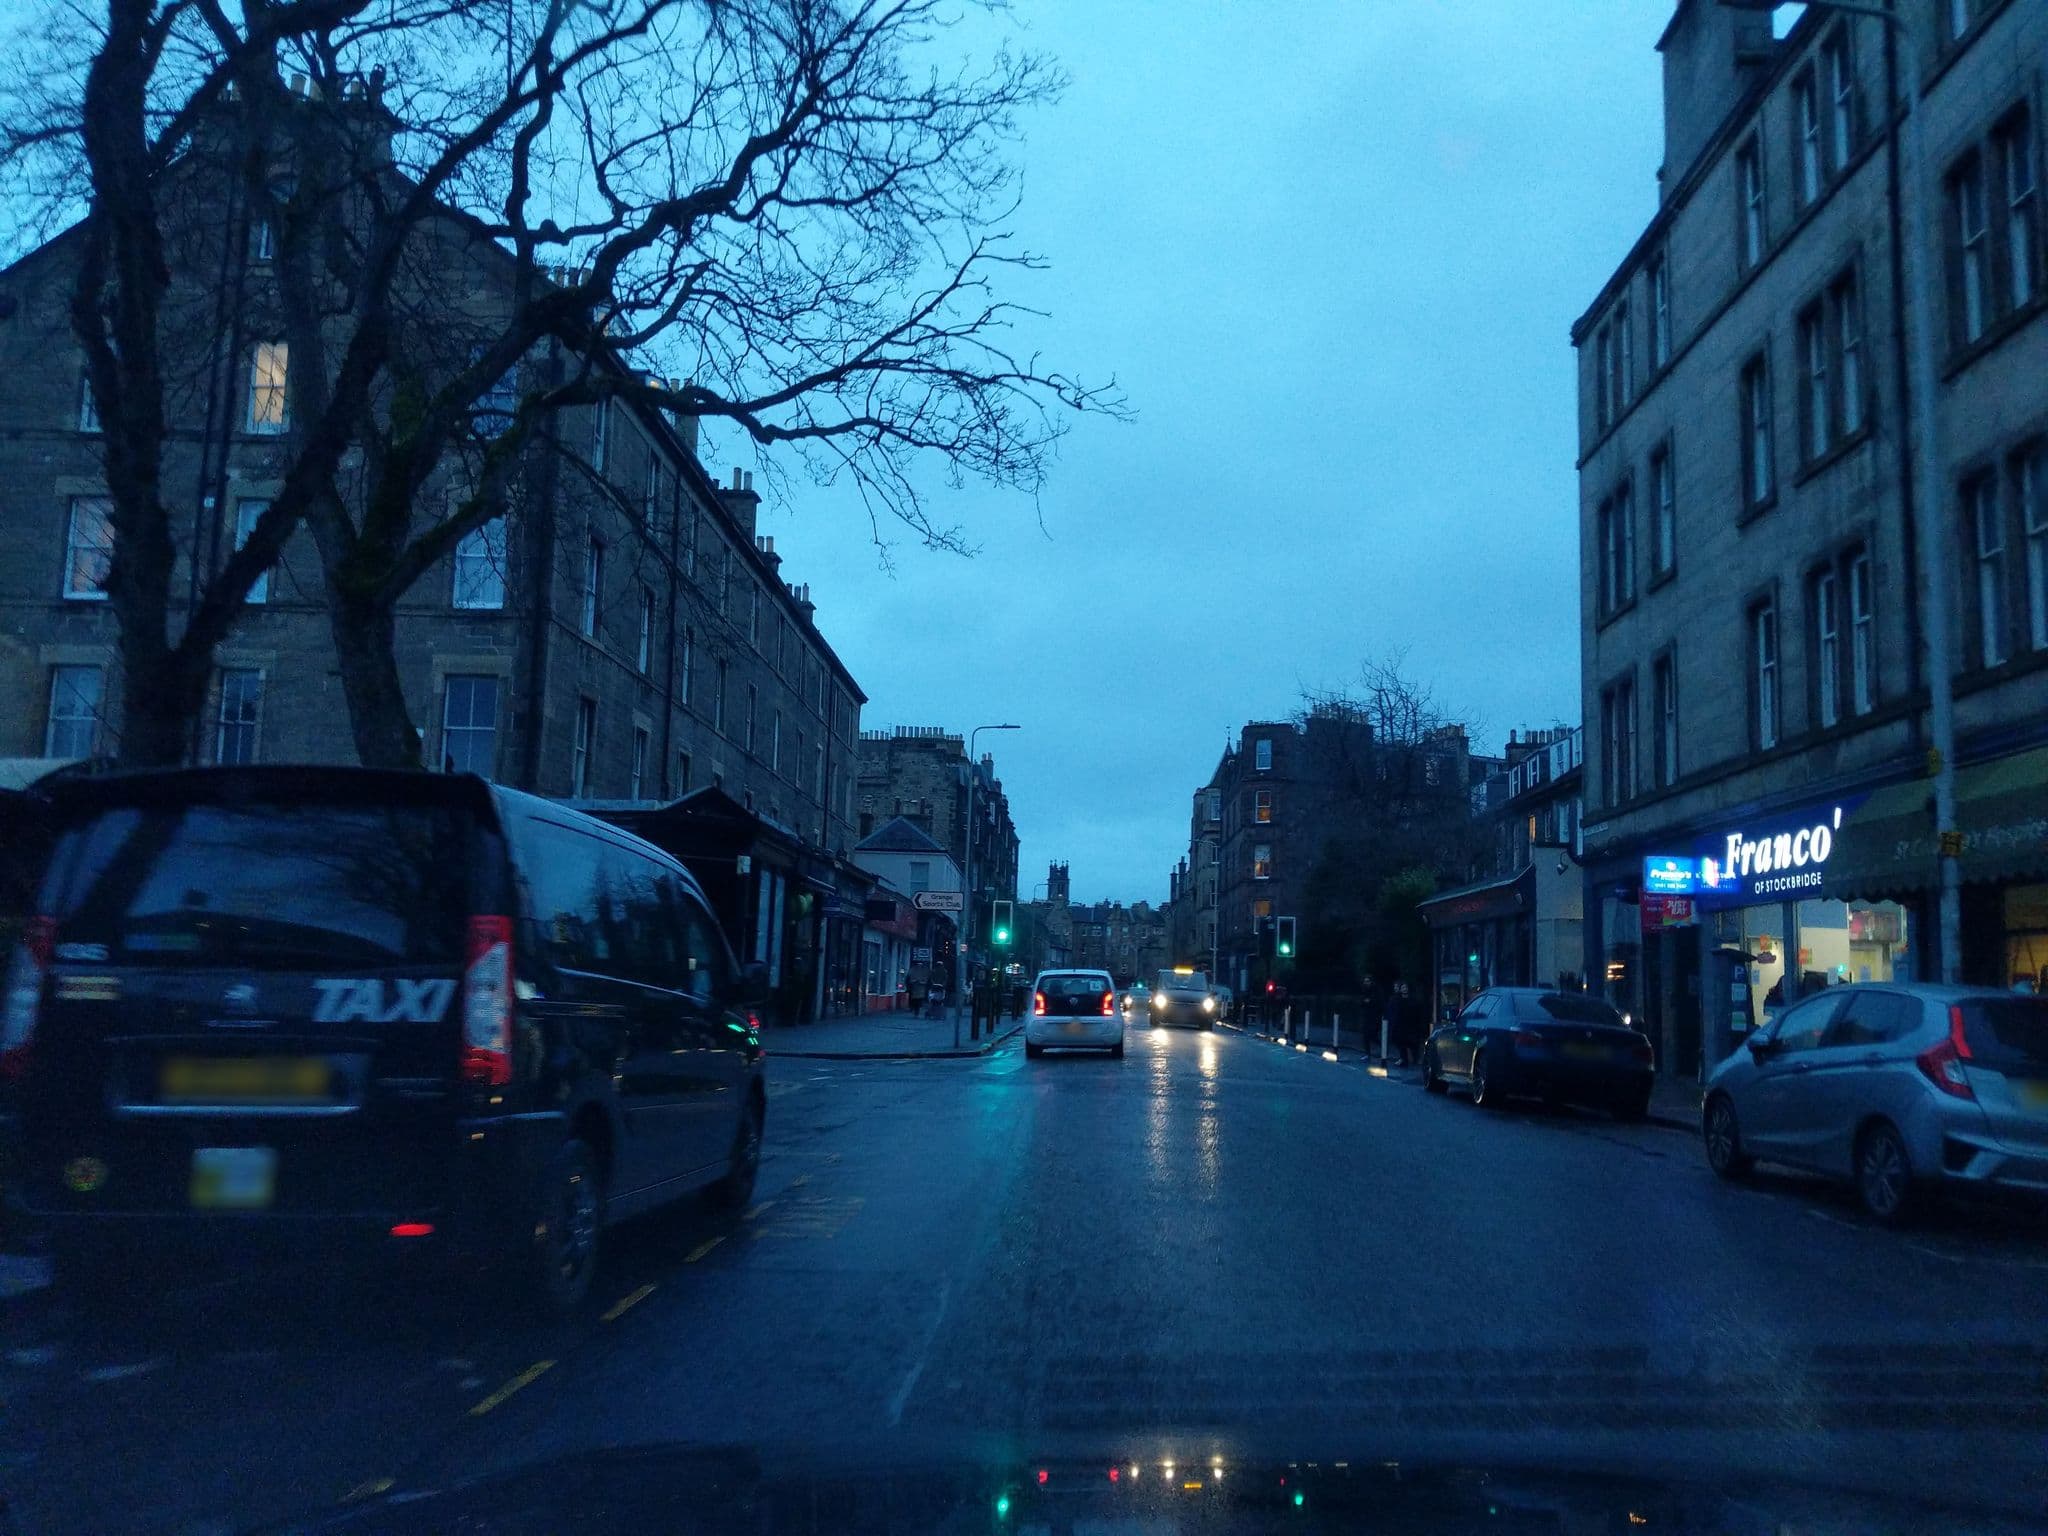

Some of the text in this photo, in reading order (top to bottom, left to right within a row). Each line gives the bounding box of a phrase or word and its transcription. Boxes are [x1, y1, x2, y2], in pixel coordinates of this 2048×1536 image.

[1754, 872, 1822, 895] OF STOCKBRIDGE
[312, 978, 459, 1023] TAXI
